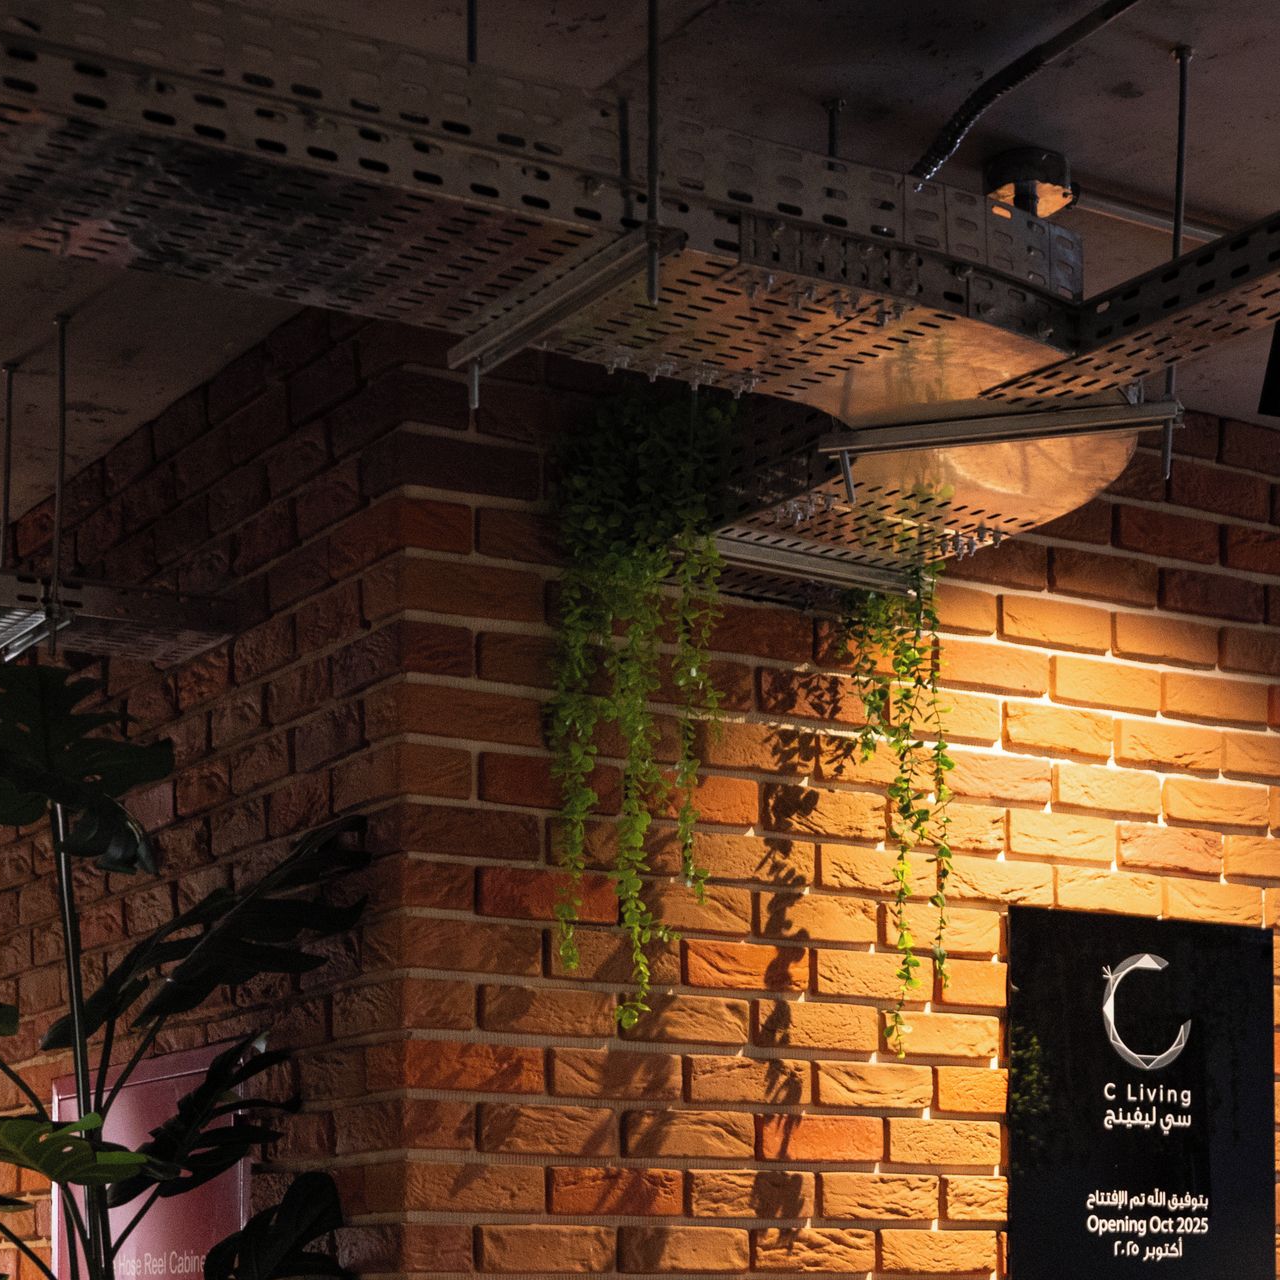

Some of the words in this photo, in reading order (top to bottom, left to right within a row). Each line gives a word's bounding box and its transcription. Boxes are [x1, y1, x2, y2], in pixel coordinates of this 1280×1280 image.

[1103, 1082, 1117, 1101] C
[1127, 1083, 1192, 1106] Living
[1103, 1106, 1158, 1130] ليفينج
[1160, 1112, 1192, 1135] سي
[1129, 1192, 1146, 1211] تم
[1167, 1191, 1209, 1211] بتوفيق
[1086, 1214, 1147, 1237] Opening
[1149, 1215, 1174, 1233] Oct
[1176, 1217, 1209, 1234] 2025
[1113, 1240, 1140, 1257] ٢٠٢٥
[1142, 1236, 1183, 1261] أكتوبر
[118, 1255, 142, 1276] Hose
[143, 1252, 167, 1275] Reel
[169, 1250, 207, 1274] Cabine
